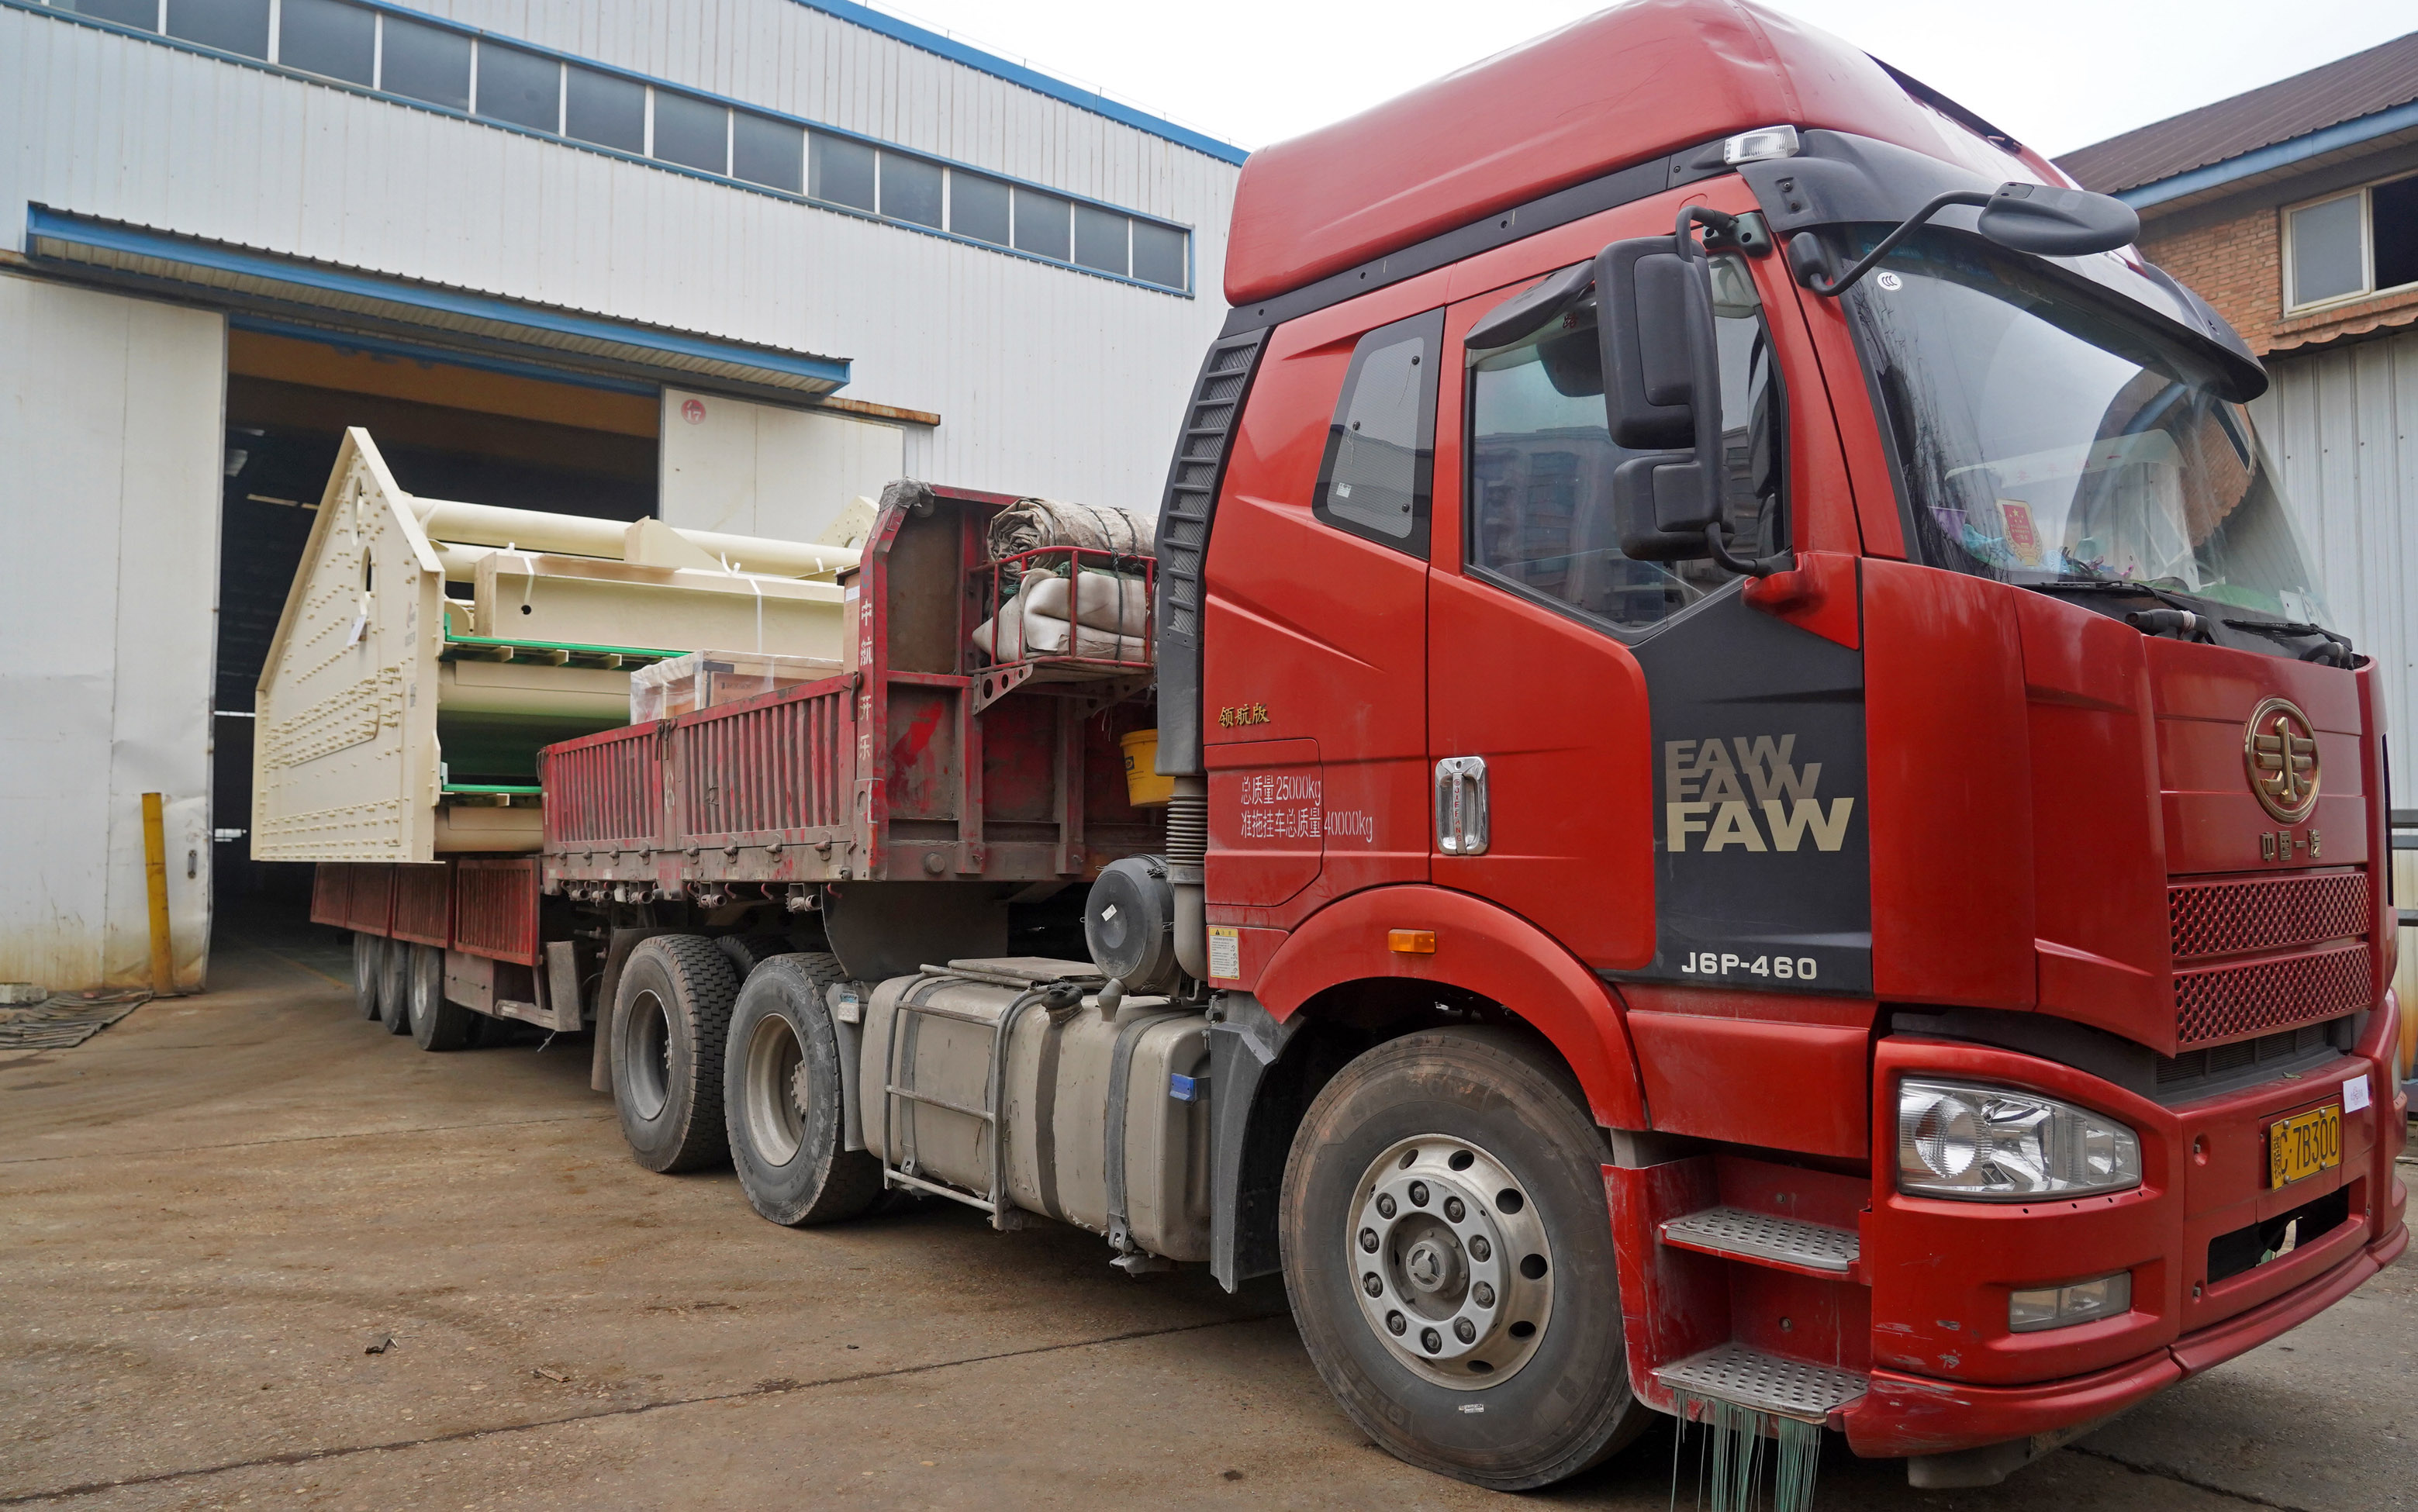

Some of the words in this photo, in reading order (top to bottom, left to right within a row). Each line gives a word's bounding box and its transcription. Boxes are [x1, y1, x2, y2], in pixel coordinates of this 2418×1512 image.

[1218, 702, 1271, 729] 领航版
[1241, 775, 1274, 806] 总质量
[1276, 774, 1321, 806] 25000kg
[1241, 807, 1321, 839] 准拖挂车总质量
[1323, 810, 1373, 844] 40000kg
[1454, 787, 1463, 842] JIEFANG
[1667, 797, 1855, 852] FAW
[2259, 829, 2321, 862] 中国一汽
[1681, 951, 1818, 981] J6P-460
